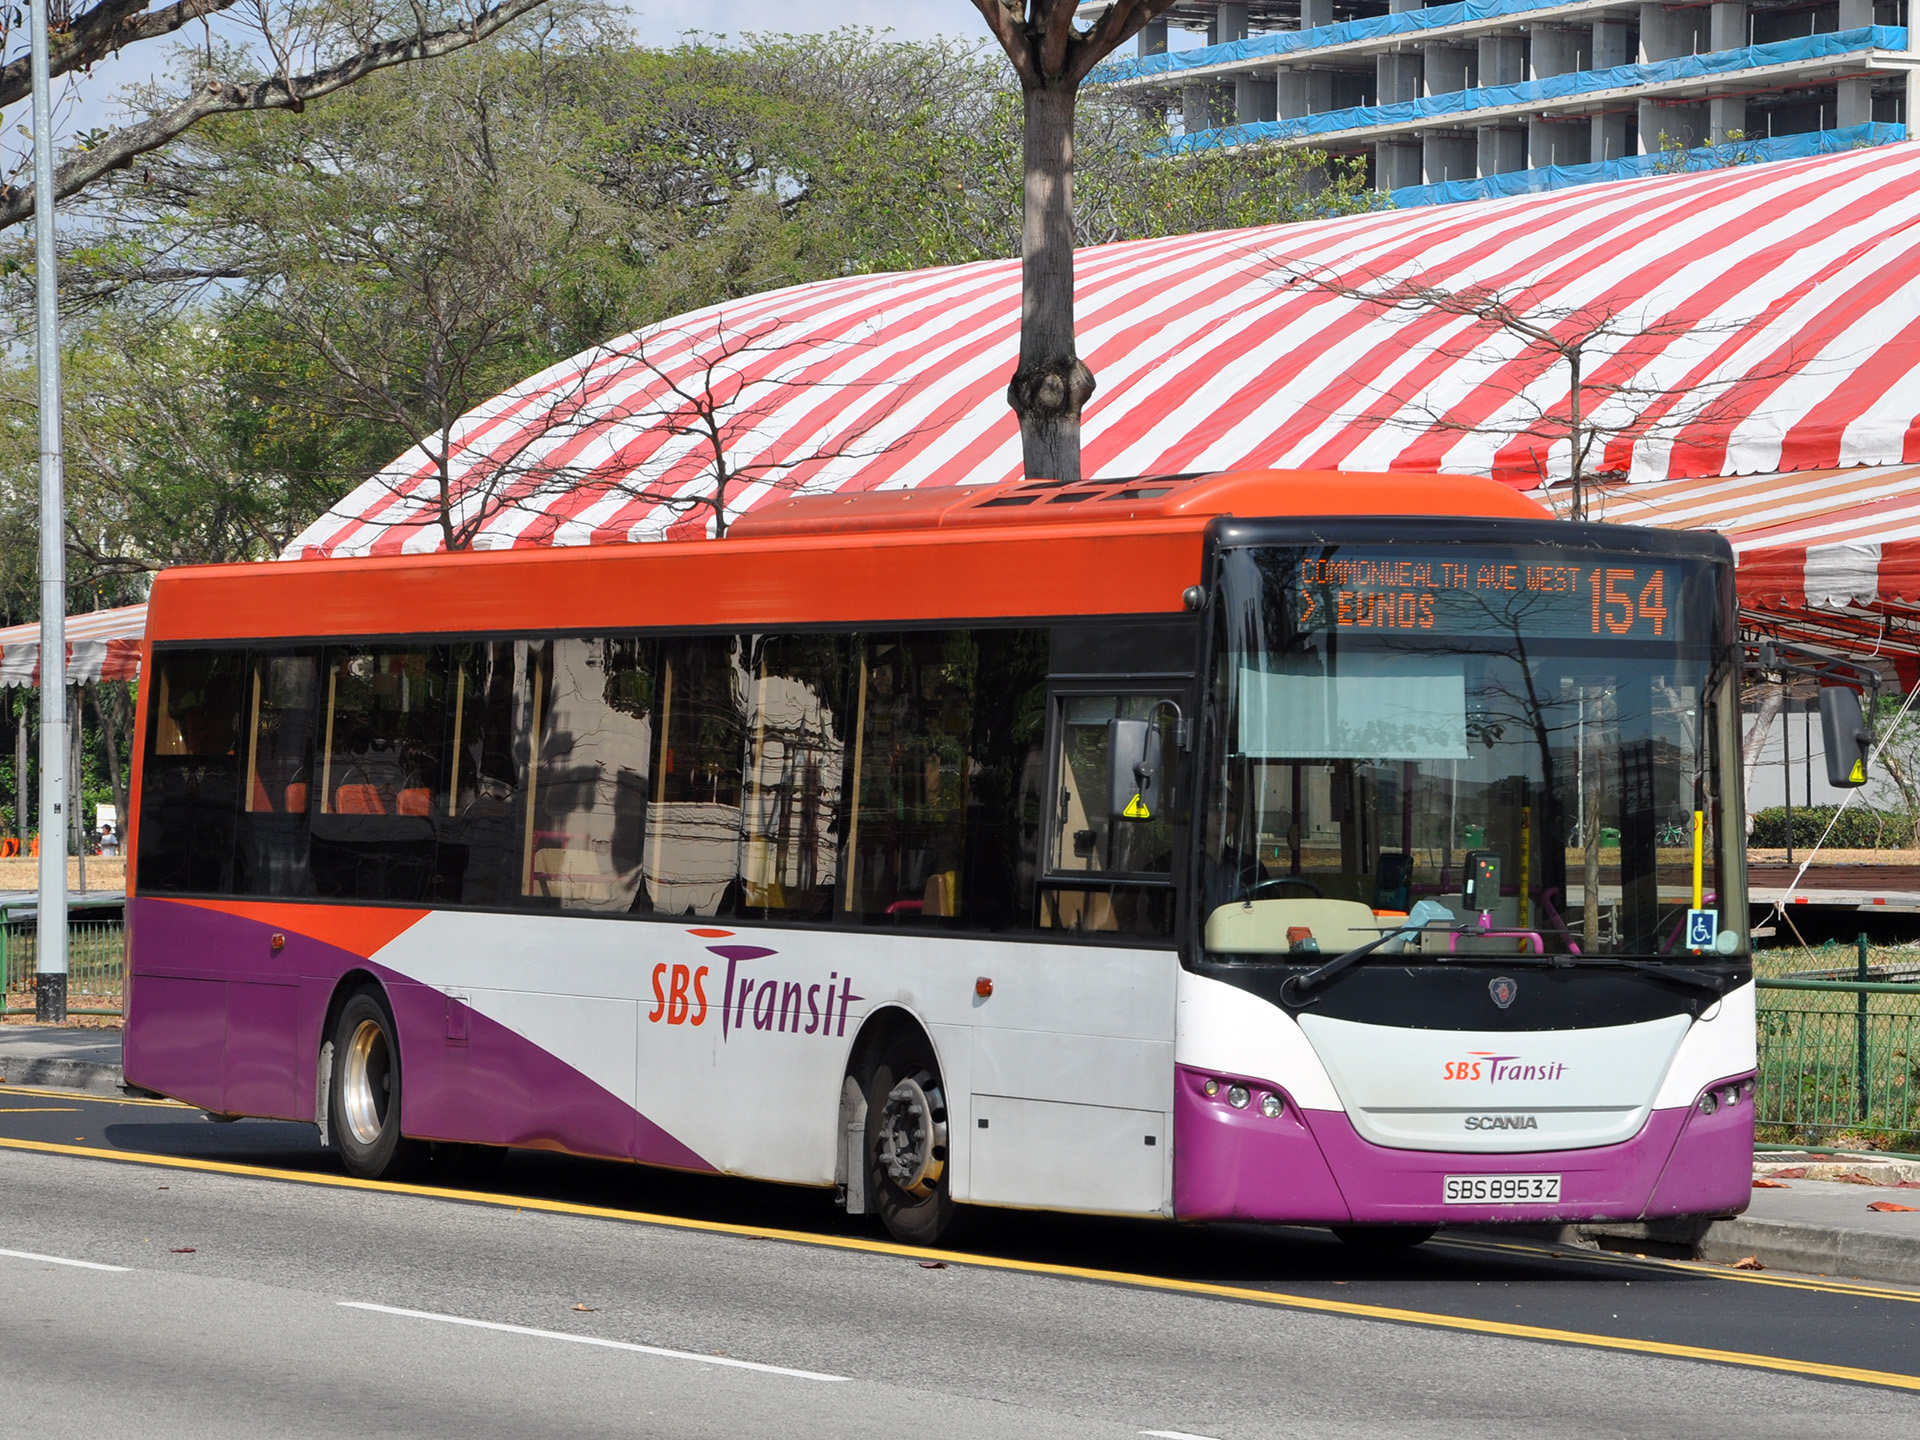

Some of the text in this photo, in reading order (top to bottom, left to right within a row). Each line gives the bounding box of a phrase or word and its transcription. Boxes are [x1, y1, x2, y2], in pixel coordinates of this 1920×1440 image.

[1301, 558, 1580, 592] COMMONWEALTH AVE WEST
[1337, 590, 1435, 628] EUNOS
[1588, 568, 1667, 635] 154
[648, 944, 867, 1044] SBS Transit
[1443, 1056, 1571, 1085] SBS Transit
[1464, 1116, 1538, 1130] SCANIA
[1446, 1179, 1559, 1200] SBS8953Z
